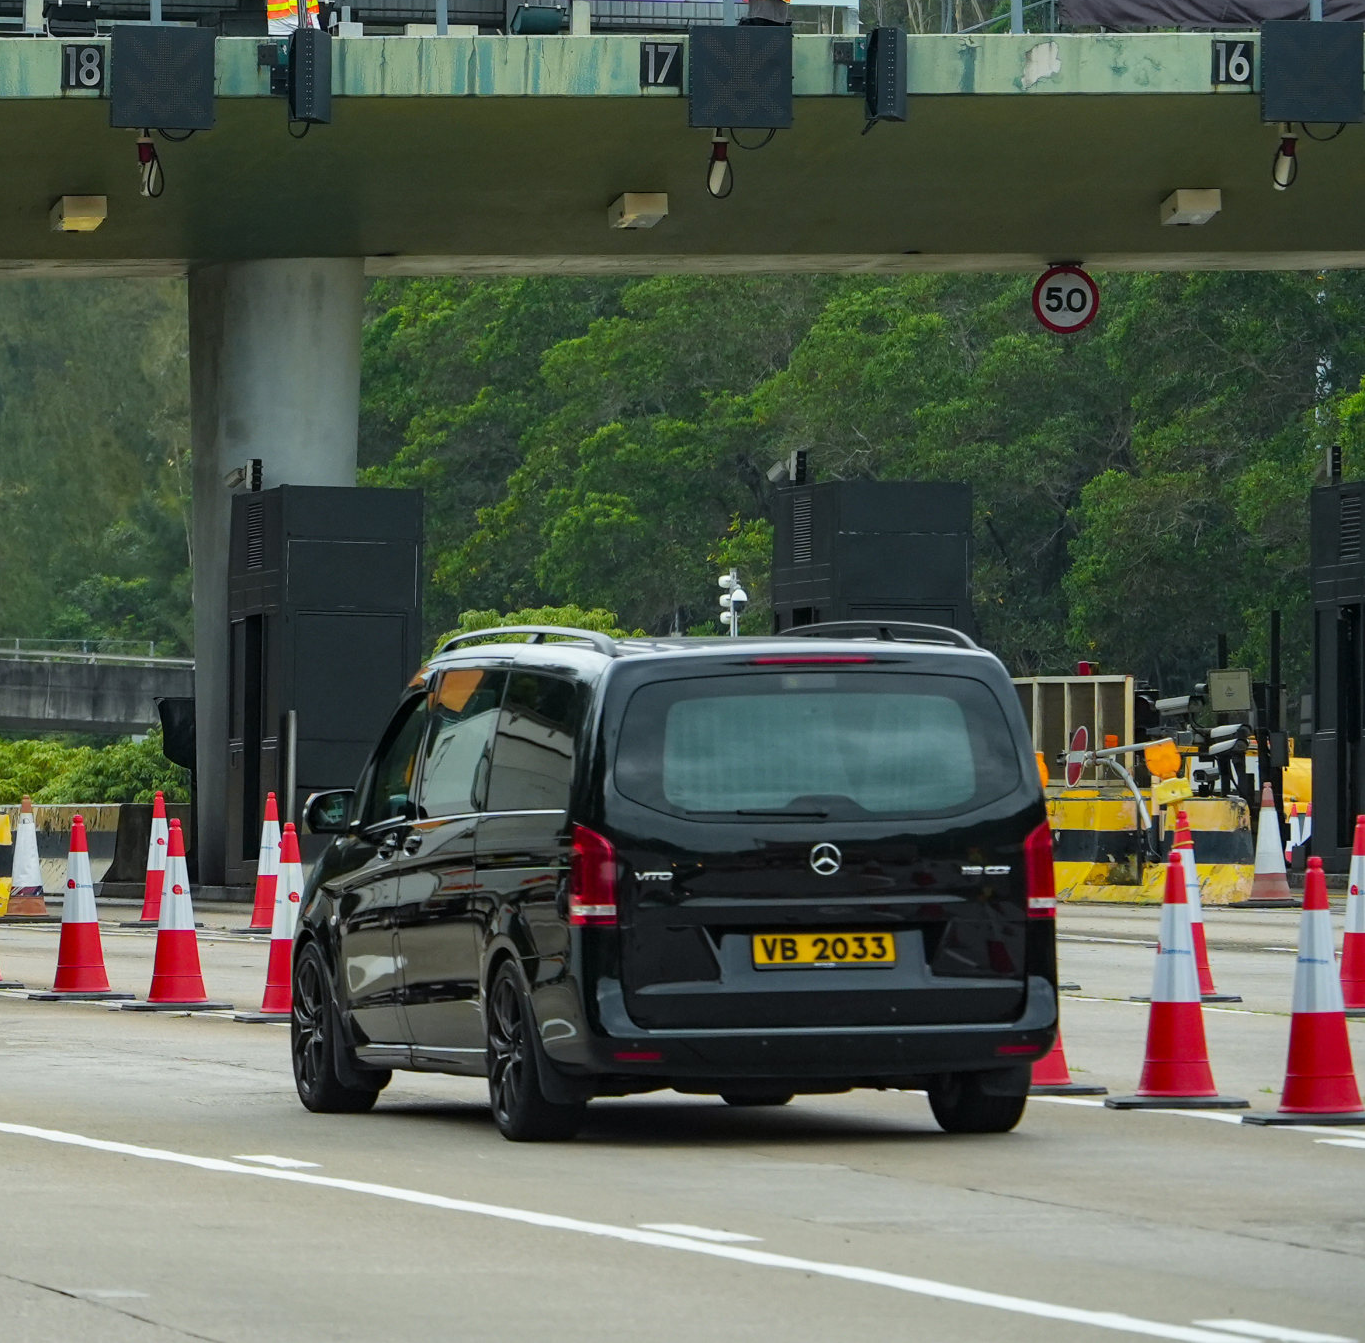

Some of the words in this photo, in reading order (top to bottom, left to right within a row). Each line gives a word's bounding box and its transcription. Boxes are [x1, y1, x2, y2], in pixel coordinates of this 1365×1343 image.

[66, 46, 101, 86] 18
[645, 44, 678, 84] 17
[1215, 42, 1250, 82] 16
[1045, 286, 1087, 313] 50
[635, 871, 674, 881] VITO
[760, 938, 798, 961] VB
[812, 936, 887, 960] 2033
